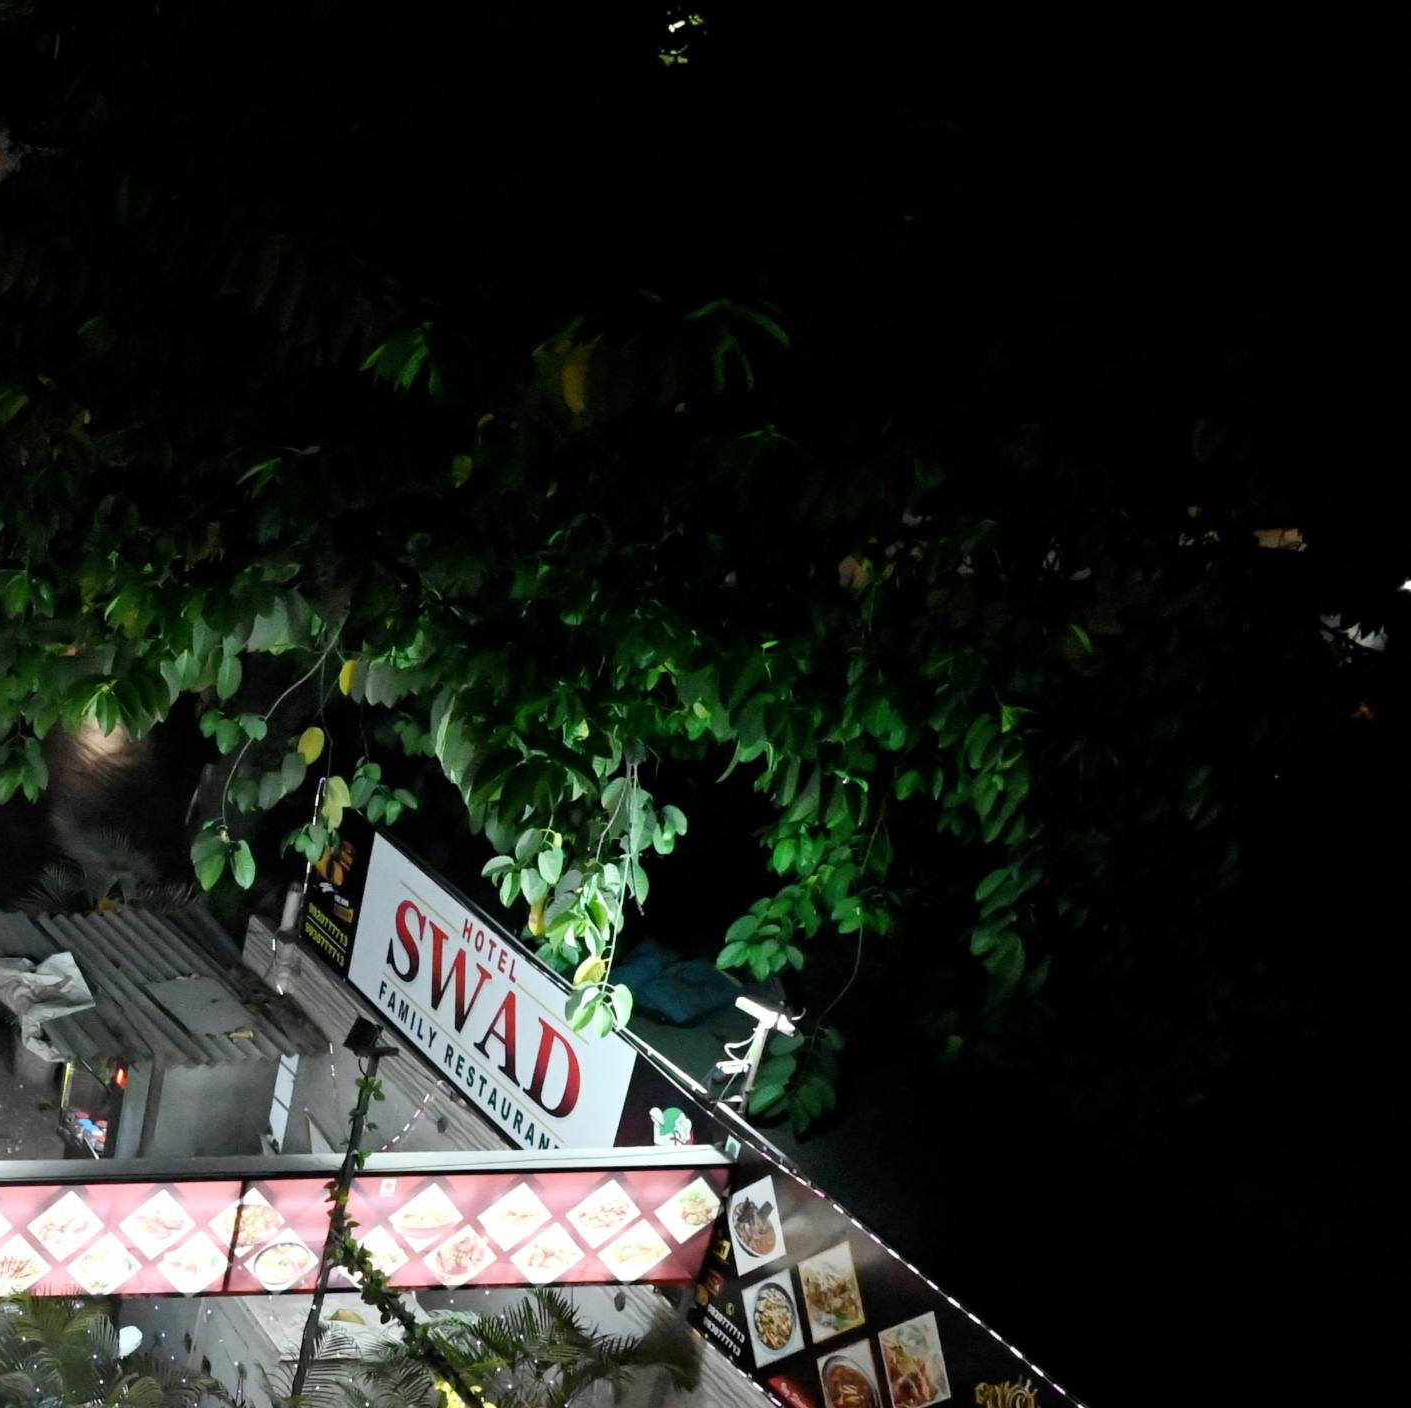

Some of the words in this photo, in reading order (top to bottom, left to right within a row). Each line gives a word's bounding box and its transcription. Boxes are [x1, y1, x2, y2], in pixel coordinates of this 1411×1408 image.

[386, 900, 581, 1118] SWAD
[462, 918, 517, 983] HOTEL
[379, 980, 437, 1048] FAMILY
[444, 1044, 560, 1149] RESTAURAN
